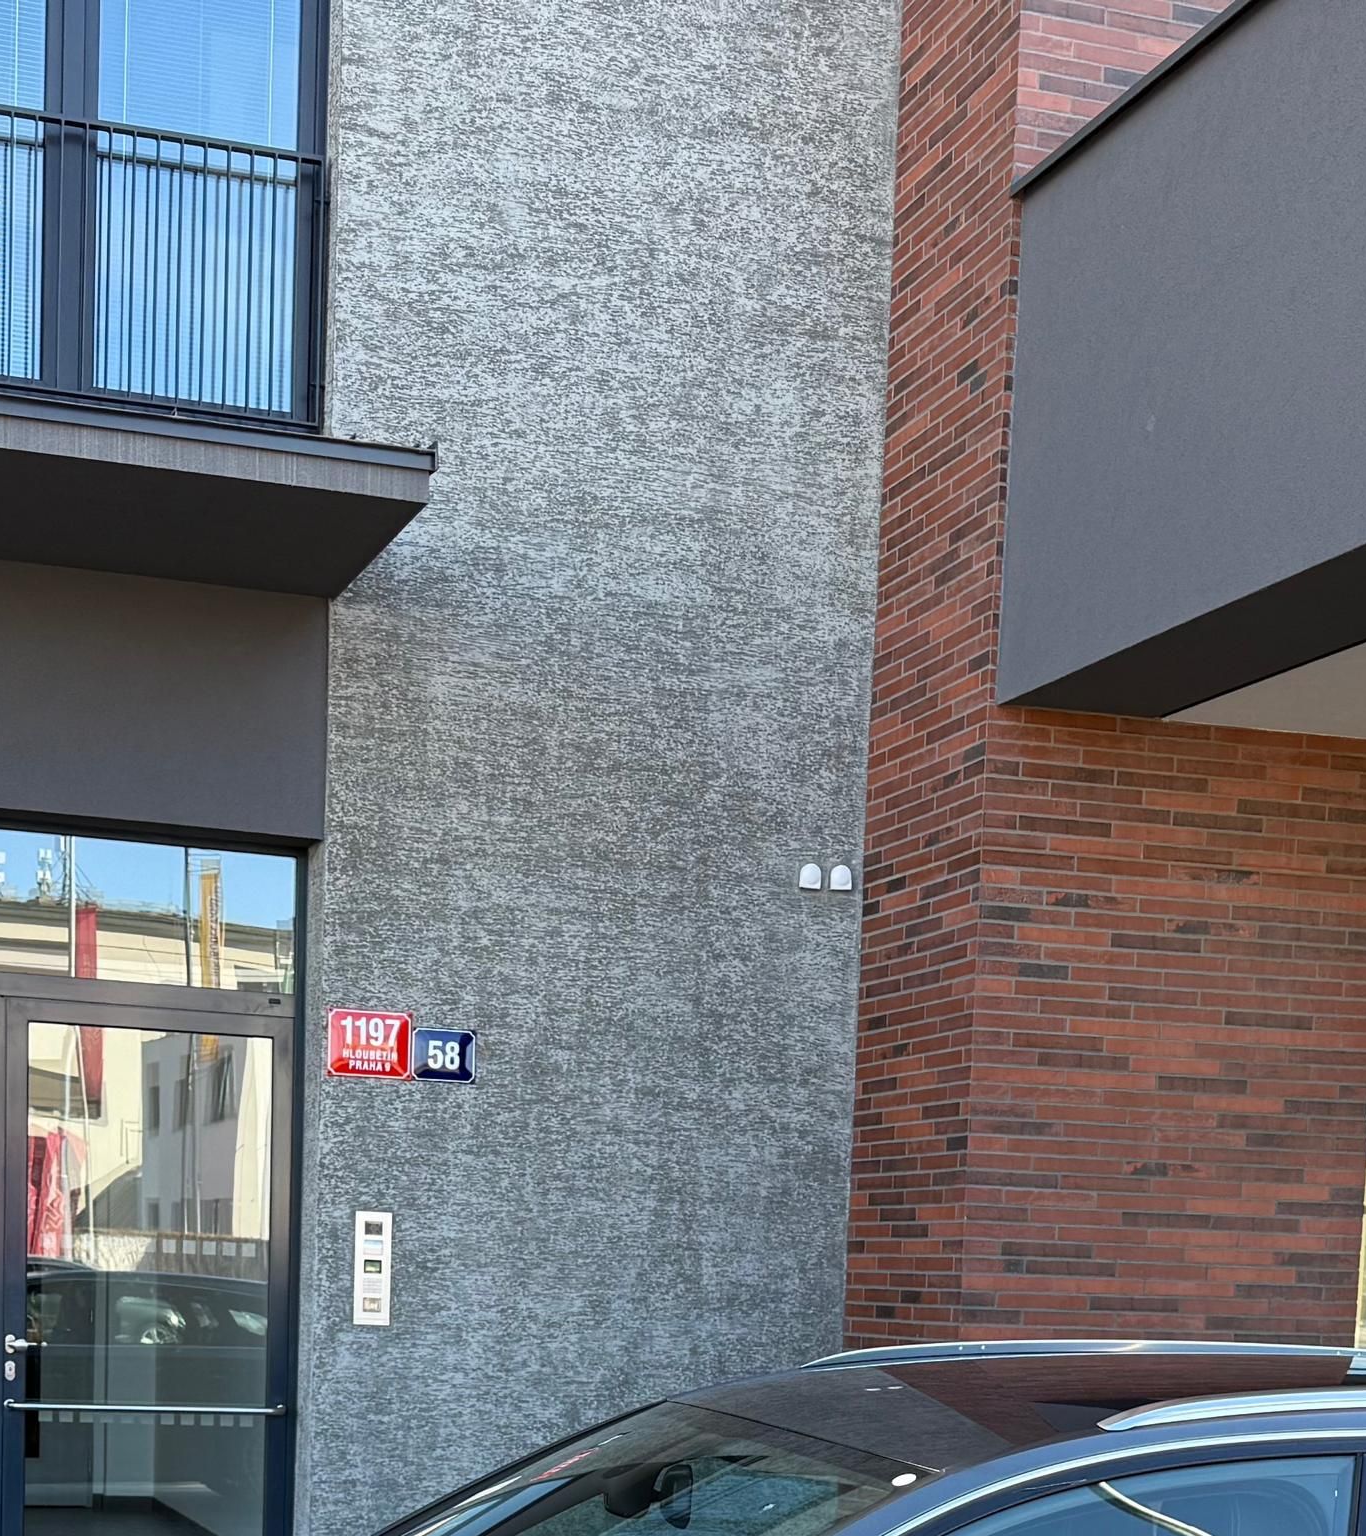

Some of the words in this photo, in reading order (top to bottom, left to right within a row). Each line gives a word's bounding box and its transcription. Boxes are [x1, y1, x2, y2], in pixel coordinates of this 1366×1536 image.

[340, 1015, 401, 1047] 1197
[348, 1059, 383, 1072] PRAHA
[384, 1062, 391, 1073] 9
[427, 1040, 461, 1071] 58
